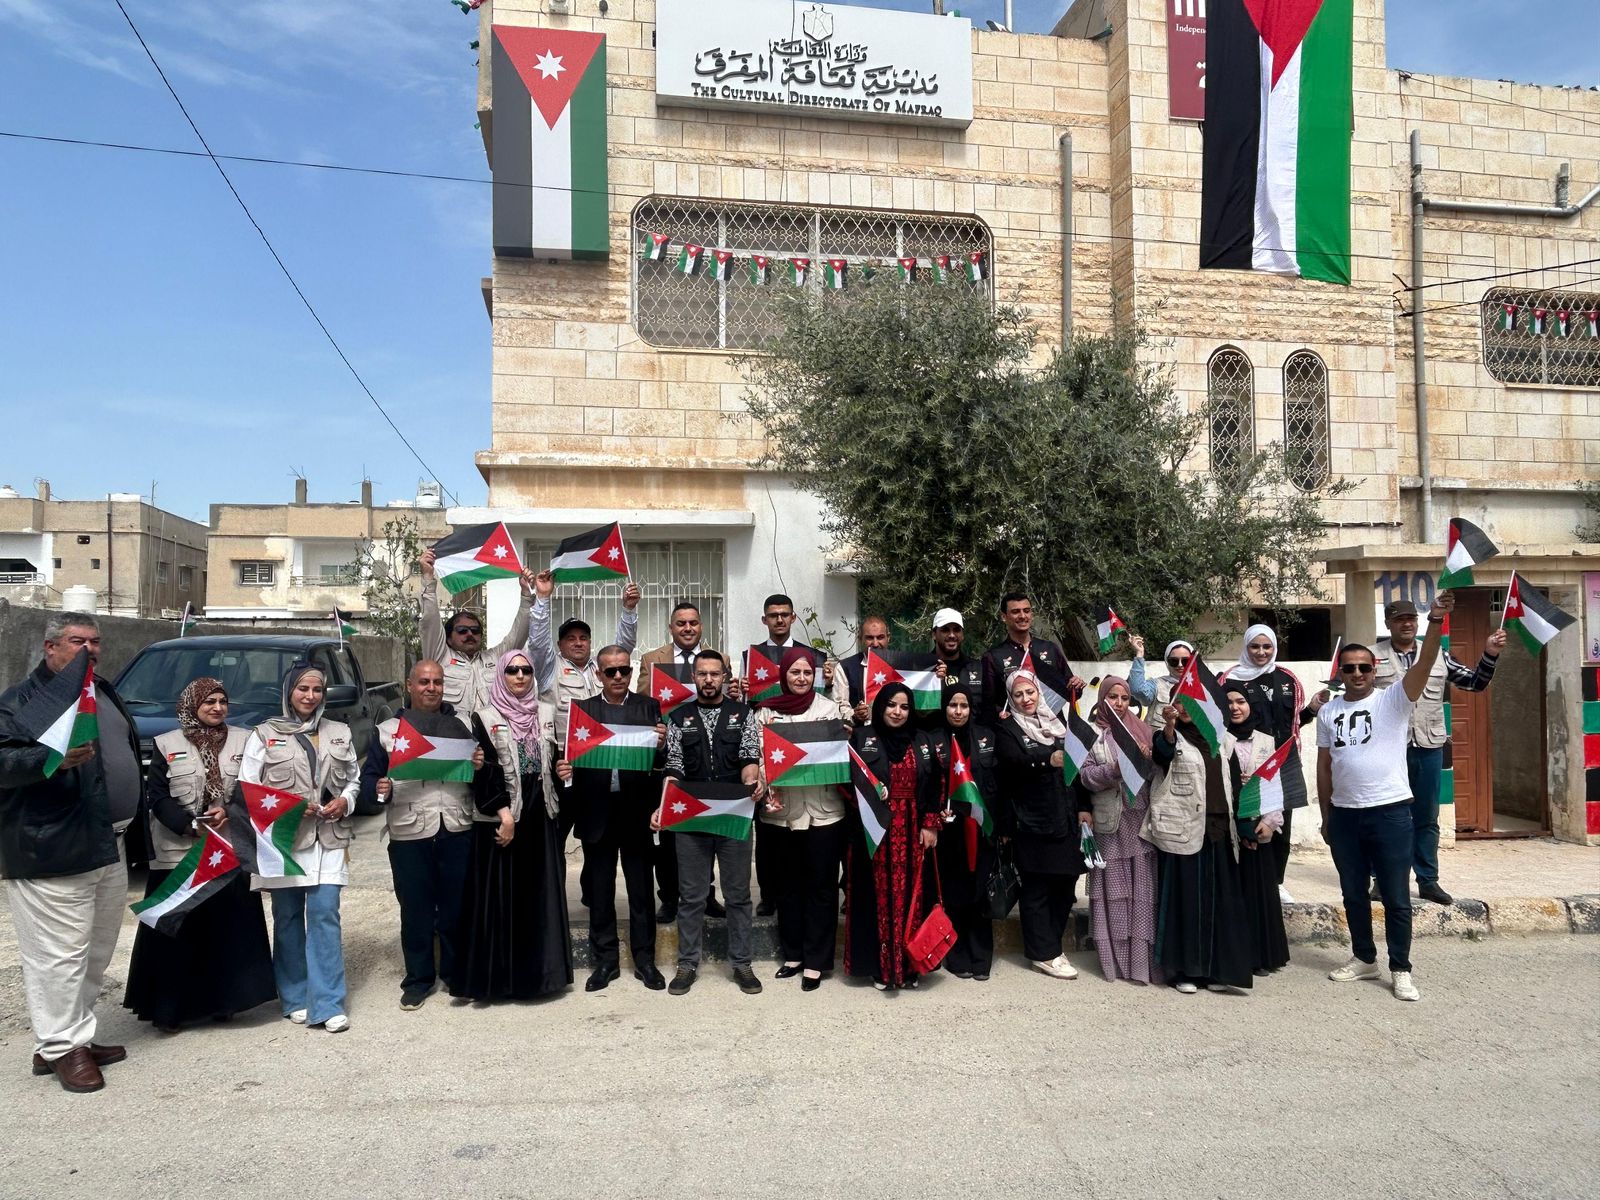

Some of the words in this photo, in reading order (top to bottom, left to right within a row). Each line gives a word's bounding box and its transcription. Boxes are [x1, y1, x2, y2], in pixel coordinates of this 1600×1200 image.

[690, 82, 717, 97] THE
[721, 85, 785, 103] CULTURAL
[789, 91, 869, 111] DIRECTORATE
[873, 98, 890, 112] OF
[895, 100, 943, 118] MAFRAQ
[1374, 570, 1435, 613] 110
